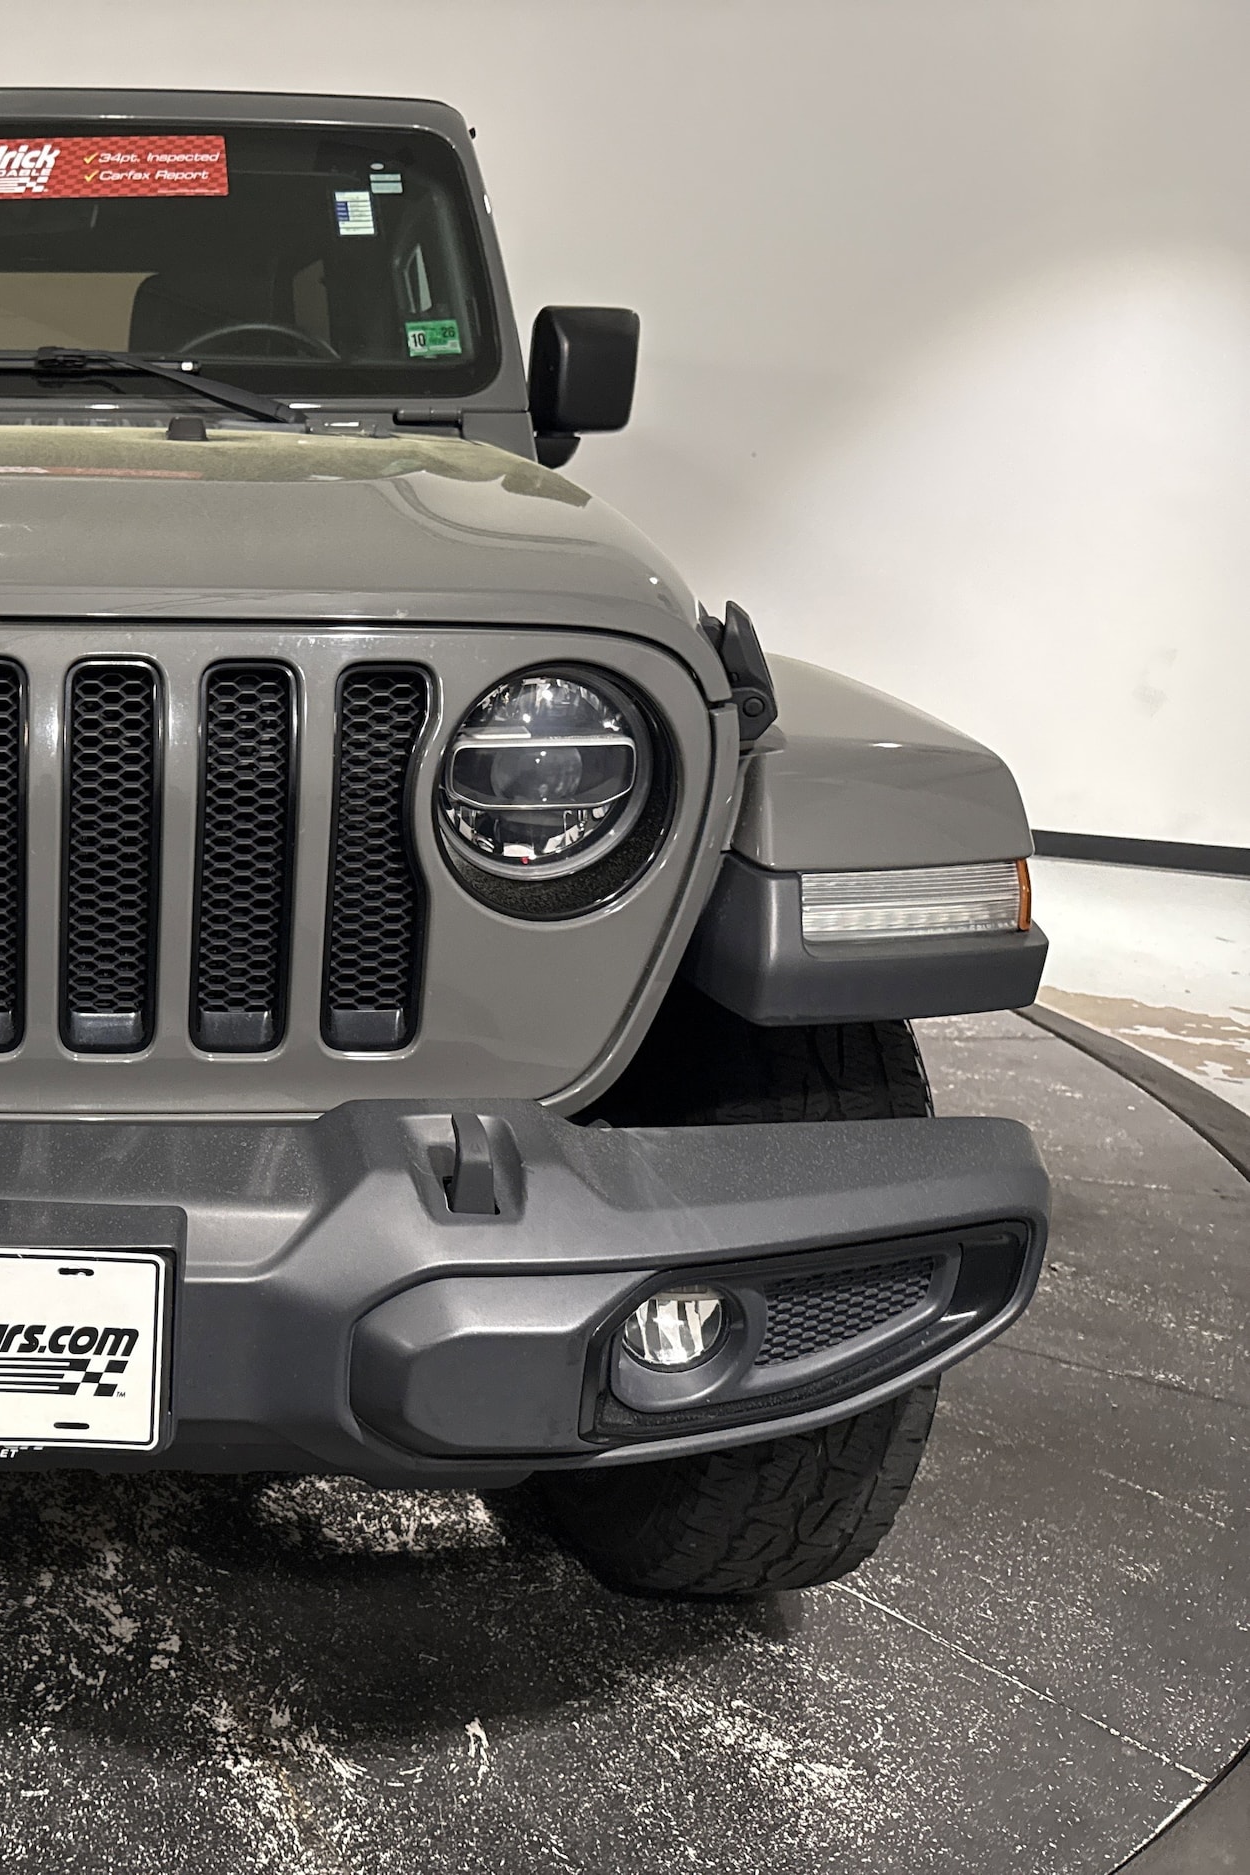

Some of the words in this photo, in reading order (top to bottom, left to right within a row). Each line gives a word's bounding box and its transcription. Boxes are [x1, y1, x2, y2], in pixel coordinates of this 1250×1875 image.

[98, 153, 140, 164] 34pt.
[147, 152, 220, 163] Inspected
[99, 170, 150, 181] Carfax
[154, 170, 209, 182] Report
[411, 332, 426, 348] 10
